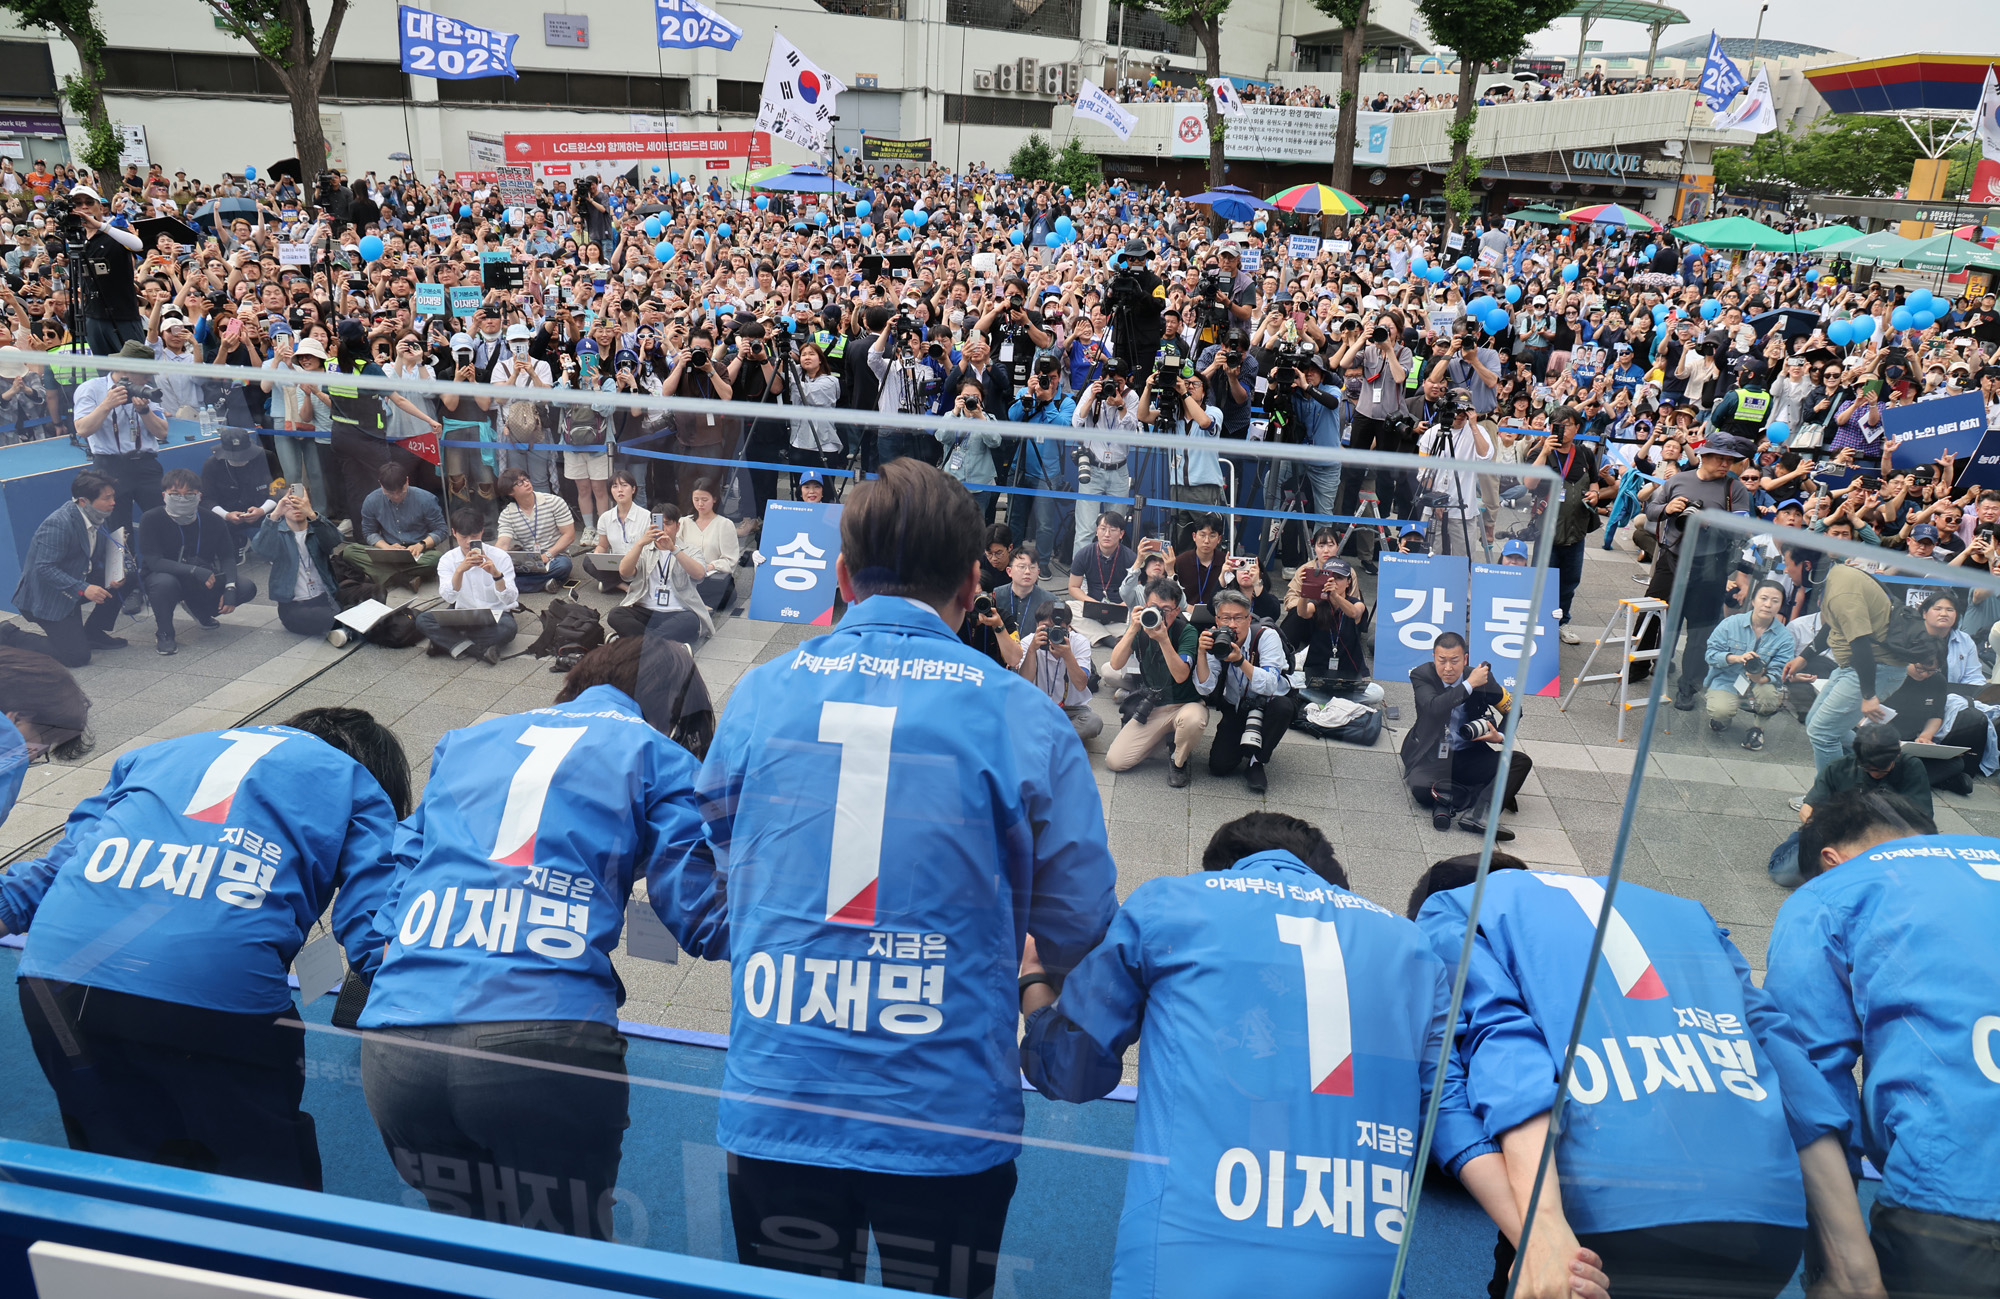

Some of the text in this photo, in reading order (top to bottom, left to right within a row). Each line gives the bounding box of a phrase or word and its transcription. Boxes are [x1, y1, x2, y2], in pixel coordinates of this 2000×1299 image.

[661, 15, 731, 43] 2025
[553, 139, 728, 154] LG트윈스와 함께하는 세이브더칠드런 데이
[1572, 151, 1682, 176] UNIQUE sports
[1914, 426, 1936, 440] 노인
[1959, 417, 1980, 431] 설치
[770, 532, 827, 591] 송
[780, 607, 800, 618] 민주당
[1391, 587, 1453, 650] 강
[1485, 597, 1545, 659] 동
[857, 653, 900, 680] 진짜
[901, 658, 985, 687] 대한민국
[182, 730, 288, 824] 1
[488, 725, 588, 866] 1
[817, 701, 897, 926] 1
[218, 827, 283, 866] 지금은
[1868, 847, 1957, 861] 이제부터
[84, 835, 274, 909] 이재명
[523, 864, 595, 900] 지금은
[1205, 877, 1285, 899] 이제부터
[1286, 884, 1325, 904] 진짜
[399, 887, 590, 960] 이재명
[867, 930, 948, 960] 지금은
[1531, 871, 1668, 1000] 1
[744, 951, 945, 1034] 이재명
[1275, 913, 1354, 1097] 1
[1673, 1007, 1743, 1035] 지금은
[1565, 1033, 1768, 1105] 이재명
[1356, 1120, 1414, 1157] 지금은
[1215, 1147, 1410, 1245] 이재명
